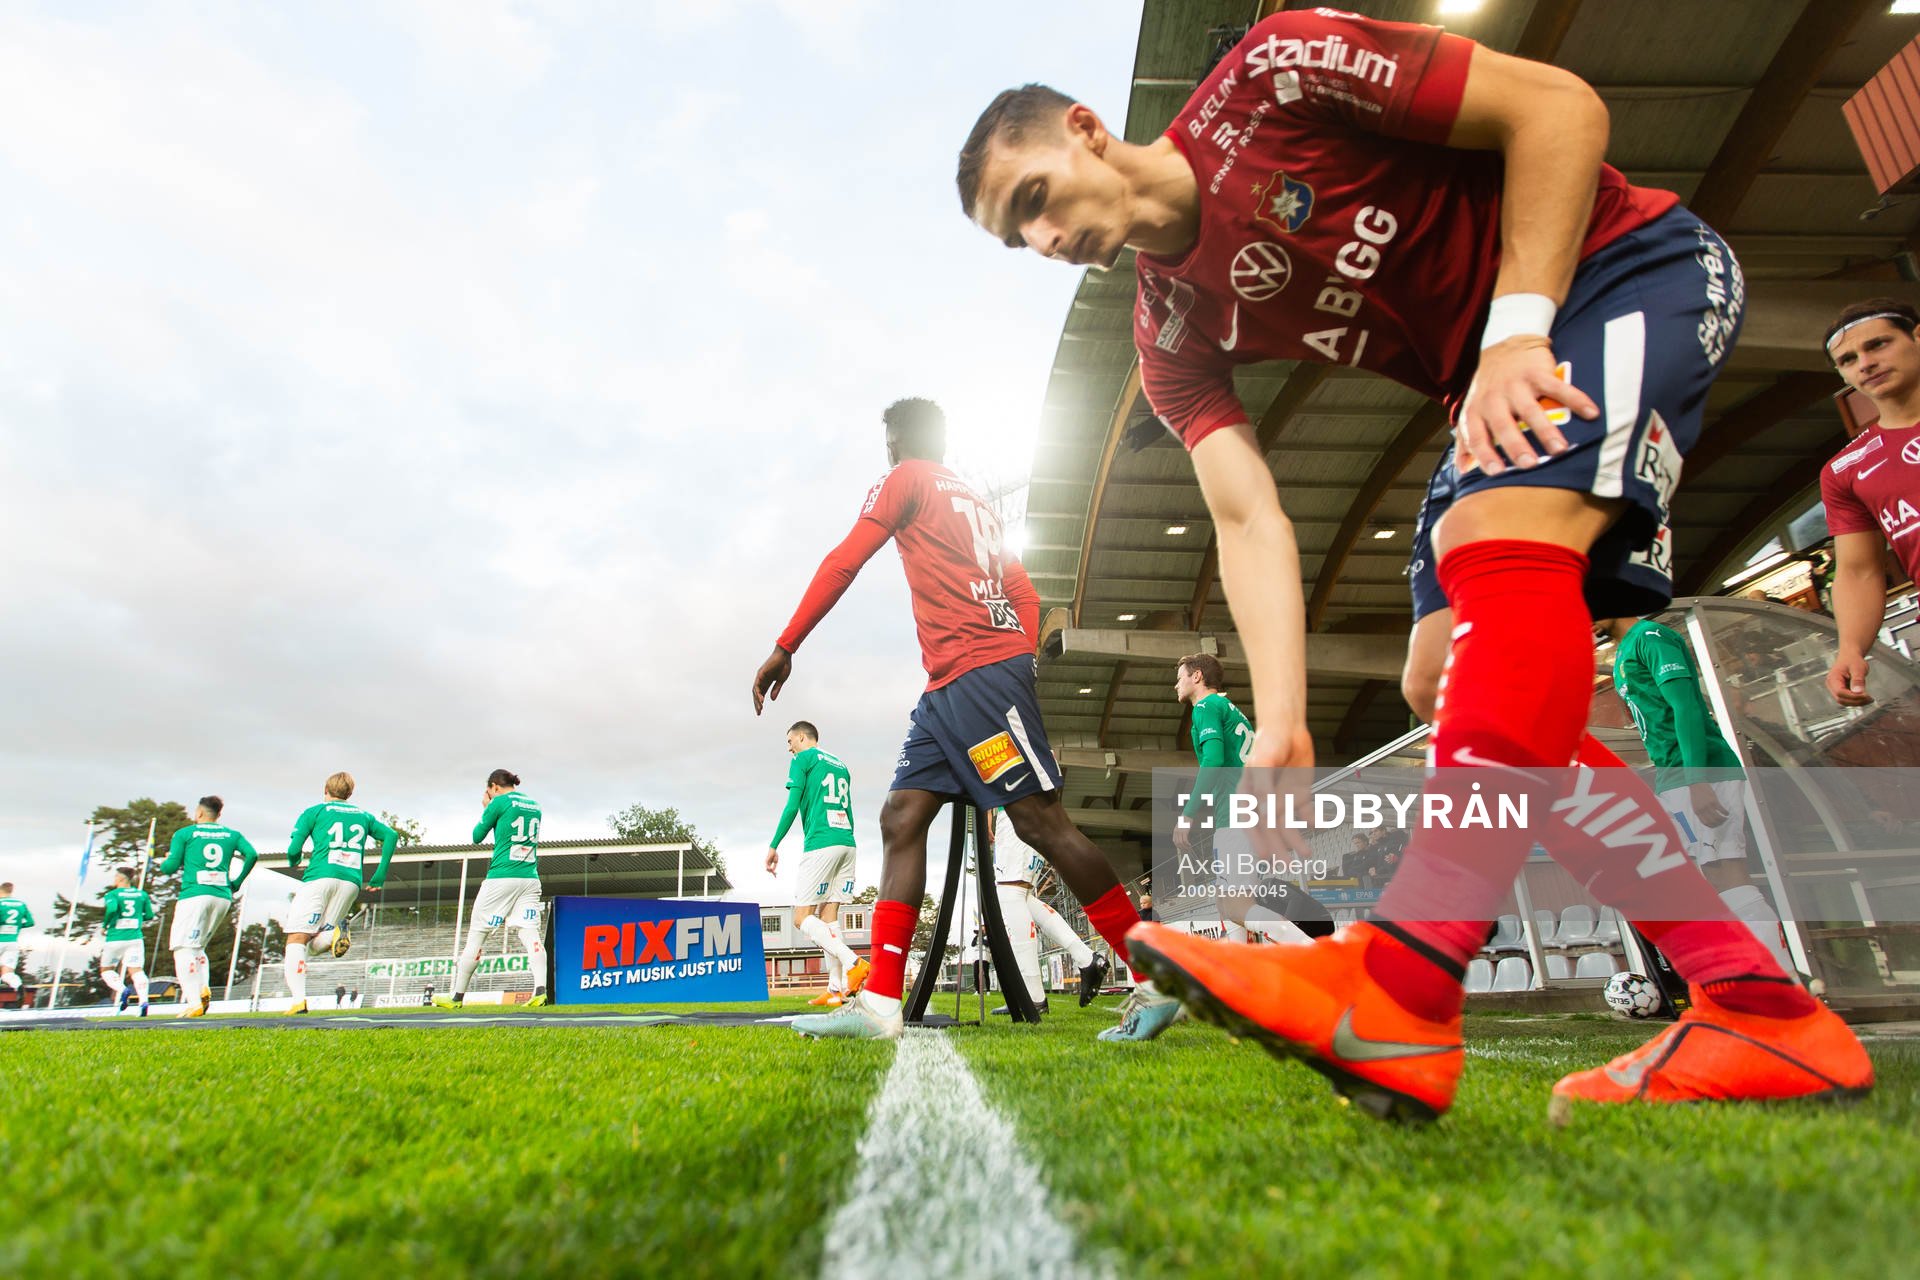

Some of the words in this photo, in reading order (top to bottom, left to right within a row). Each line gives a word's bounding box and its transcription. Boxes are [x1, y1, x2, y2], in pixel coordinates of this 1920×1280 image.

[1188, 69, 1238, 140] BJELIN
[1210, 147, 1238, 195] ERNST
[971, 737, 1010, 763] TRIUMF
[821, 772, 849, 809] 18
[327, 821, 366, 850] 12
[510, 815, 541, 844] 10
[202, 843, 223, 868] 9
[5, 909, 19, 924] 2
[121, 900, 136, 917] 3
[580, 970, 623, 990] BÄST
[626, 965, 676, 984] MUSIK
[679, 961, 716, 978] JUST
[717, 957, 742, 973] NU!
